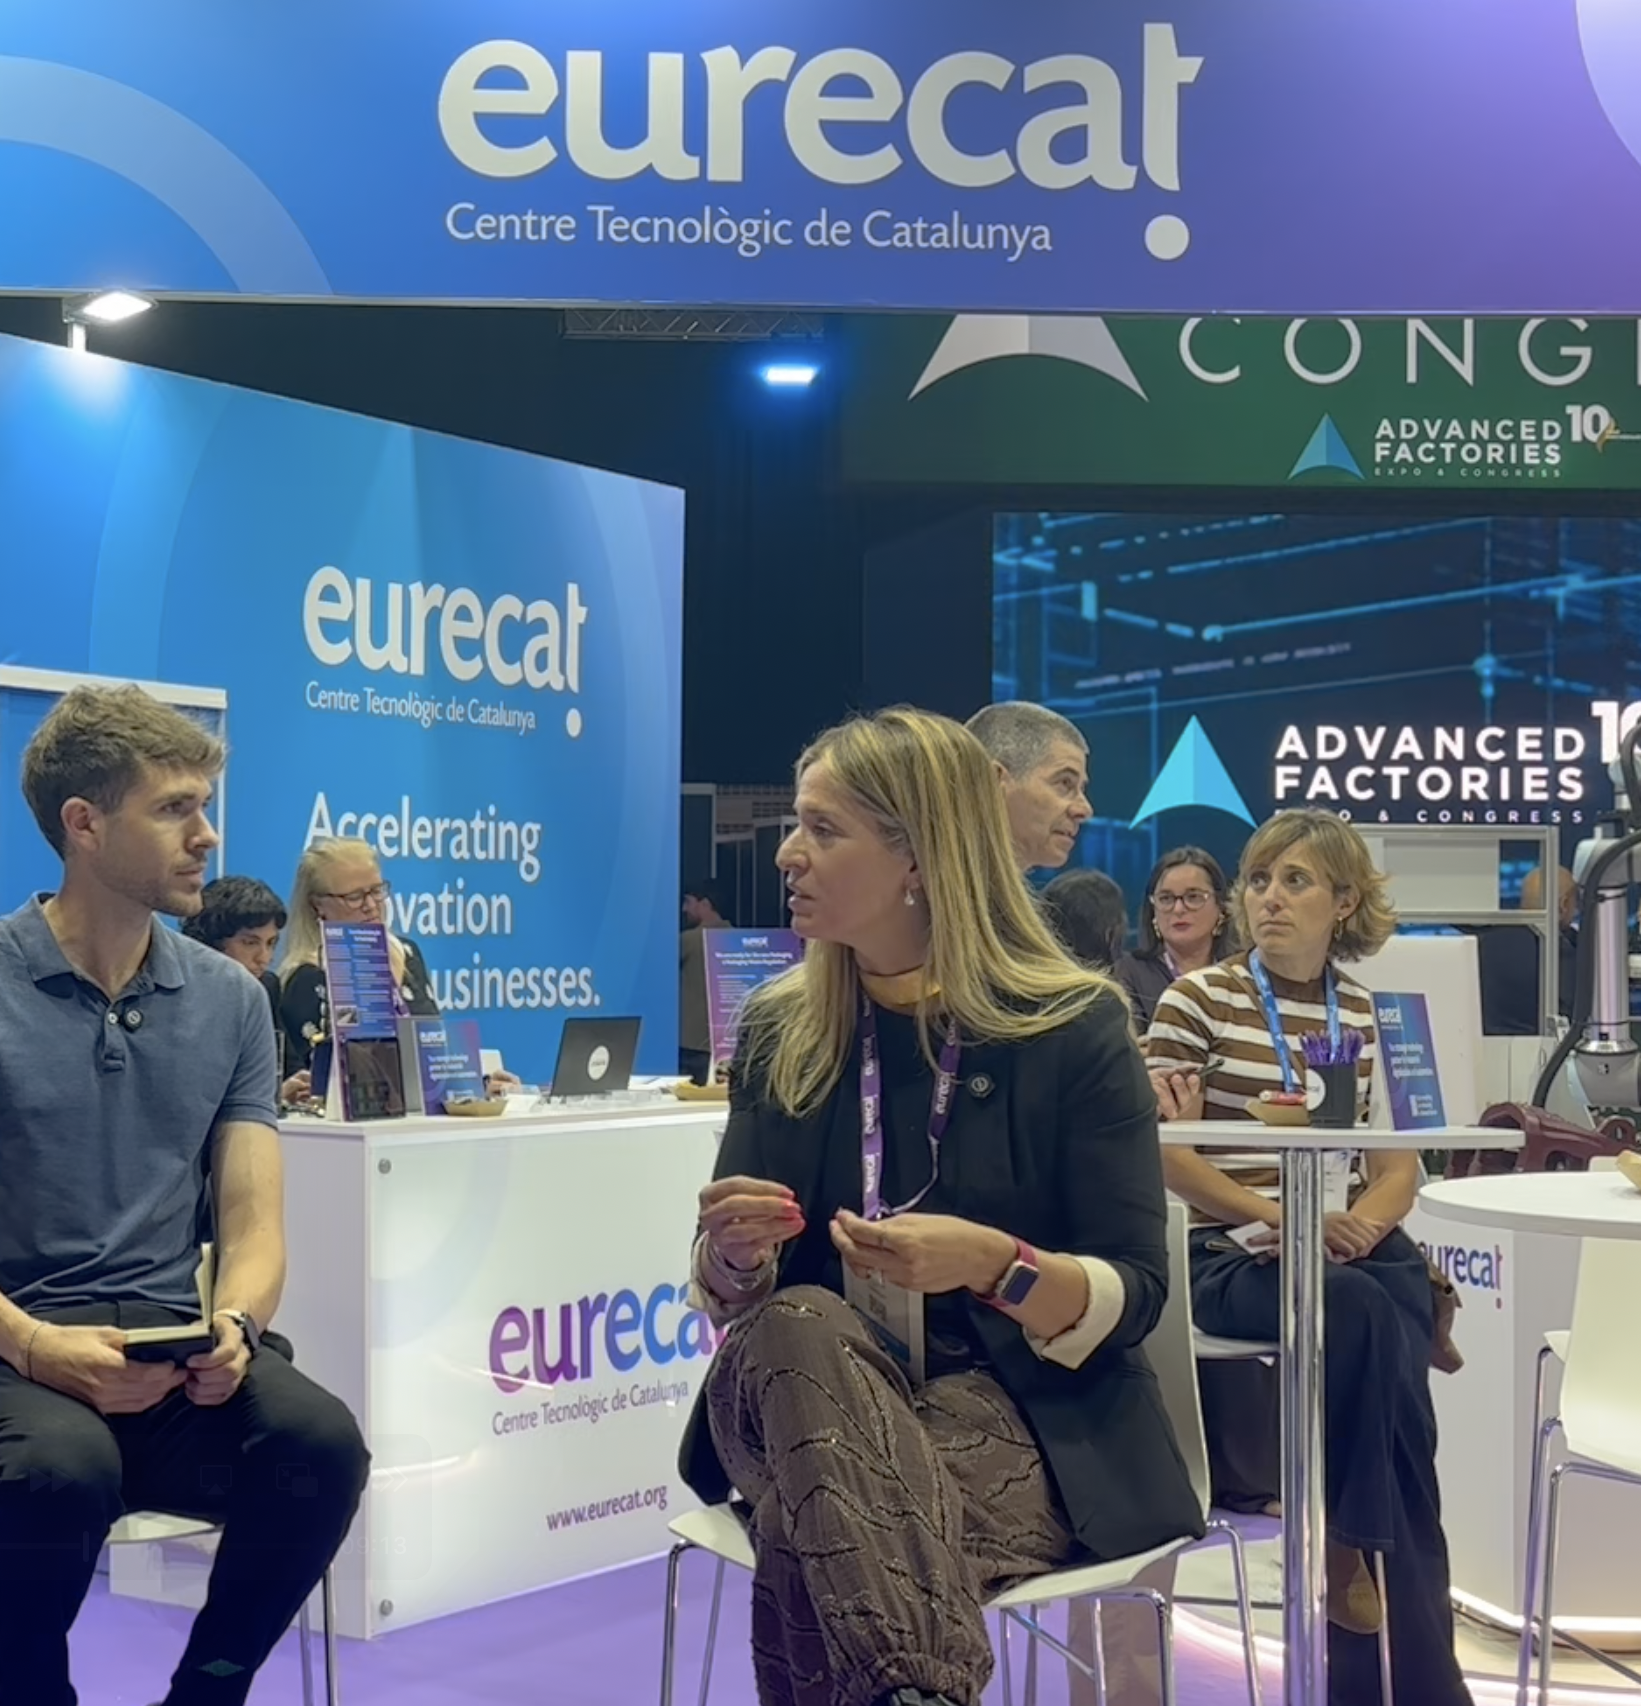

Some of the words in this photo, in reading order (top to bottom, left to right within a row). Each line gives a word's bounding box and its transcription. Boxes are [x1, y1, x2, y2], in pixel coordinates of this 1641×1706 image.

[438, 23, 1204, 191] eurecat
[446, 202, 576, 241] Centre
[587, 205, 793, 258] Tecnològic
[804, 208, 851, 246] de
[863, 209, 1052, 262] Catalunya
[1179, 318, 1641, 387] CONG
[1375, 419, 1562, 441] ADVANCED
[1565, 405, 1611, 443] 10
[1375, 443, 1562, 464] FACTORIES
[1375, 467, 1422, 477] EXPO
[1460, 468, 1561, 478] CONGRESS
[303, 566, 588, 693] eurecat
[306, 681, 359, 712] Centre
[363, 687, 442, 728] Tecnològic
[446, 696, 464, 722] de
[468, 699, 536, 736] Catalunya
[1275, 725, 1585, 761] ADVANCED
[1275, 766, 1584, 801] FACTORIES
[1417, 810, 1583, 823] CONGRESS
[431, 952, 601, 1010] usinesses.
[489, 1283, 728, 1393] eureca
[492, 1411, 538, 1435] Centre
[541, 1392, 608, 1423] Tecnològic
[611, 1389, 627, 1411] de
[629, 1378, 688, 1408] Catalunya
[546, 1485, 667, 1531] www.eurecat.org
